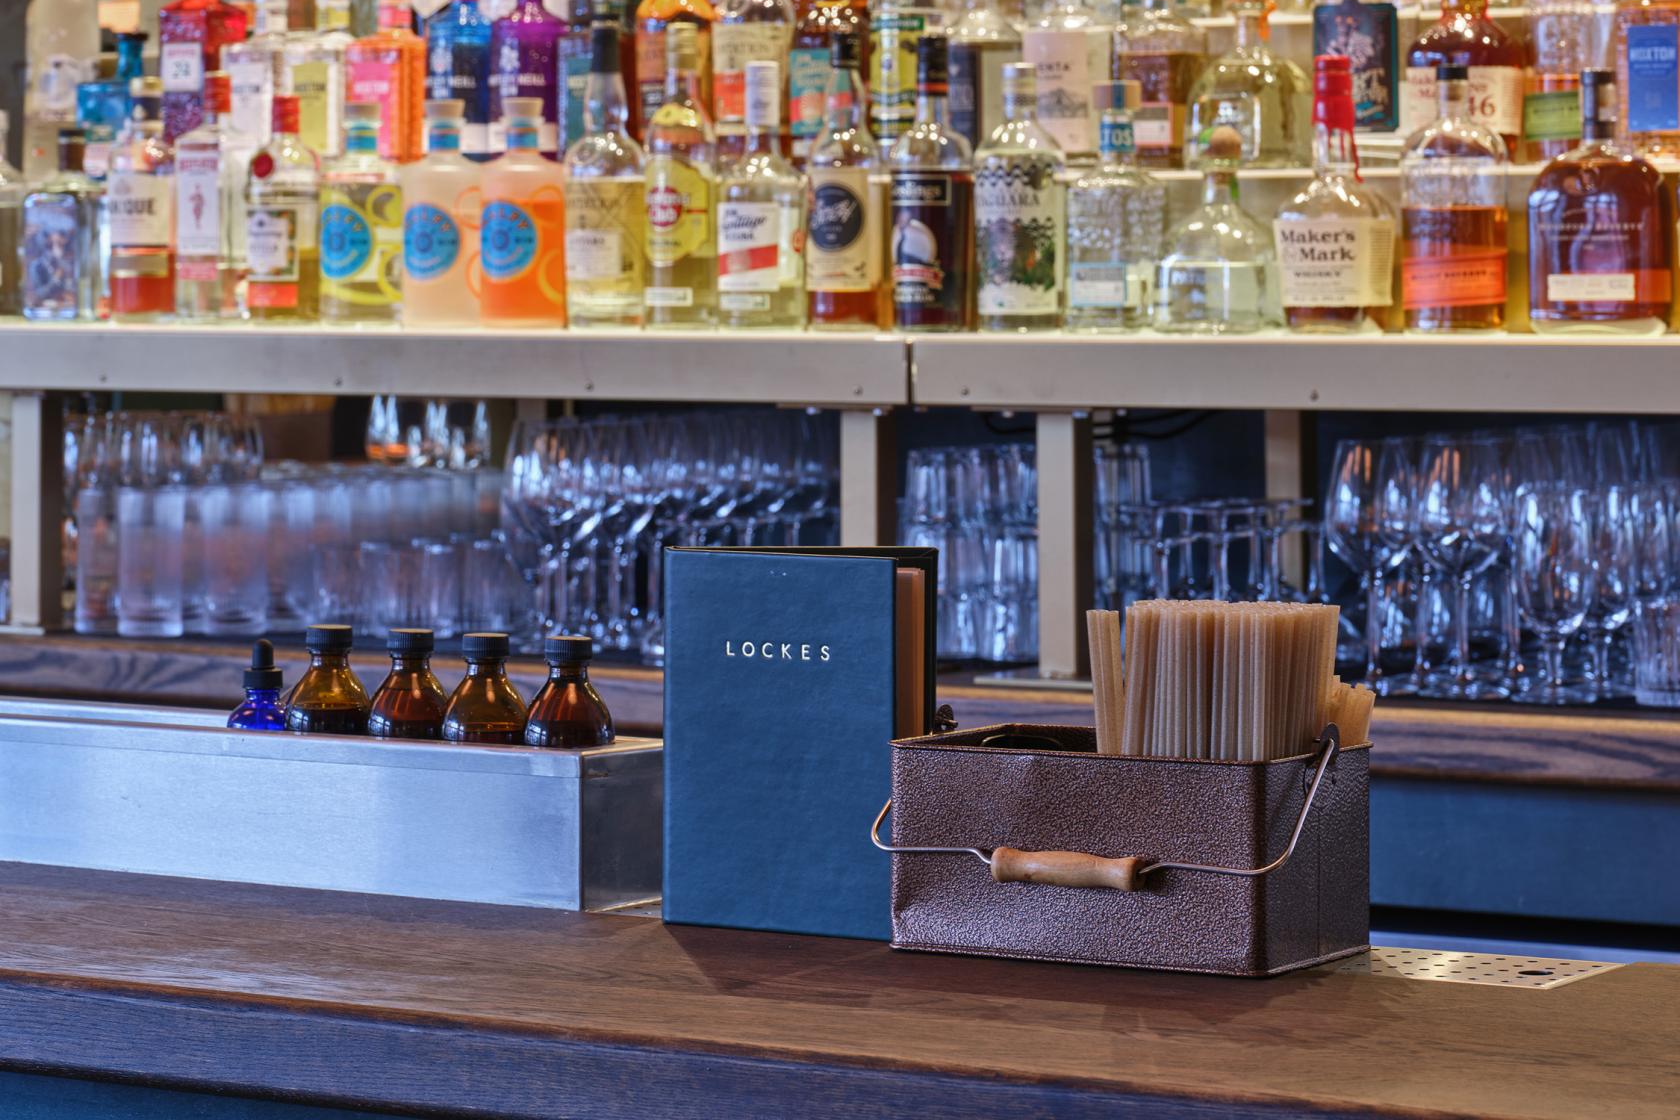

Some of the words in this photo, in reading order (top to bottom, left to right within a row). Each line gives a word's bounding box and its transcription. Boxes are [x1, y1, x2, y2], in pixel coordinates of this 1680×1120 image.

[1280, 227, 1356, 243] Maker's
[1299, 246, 1356, 261] Mark
[725, 640, 831, 662] LOCKES
